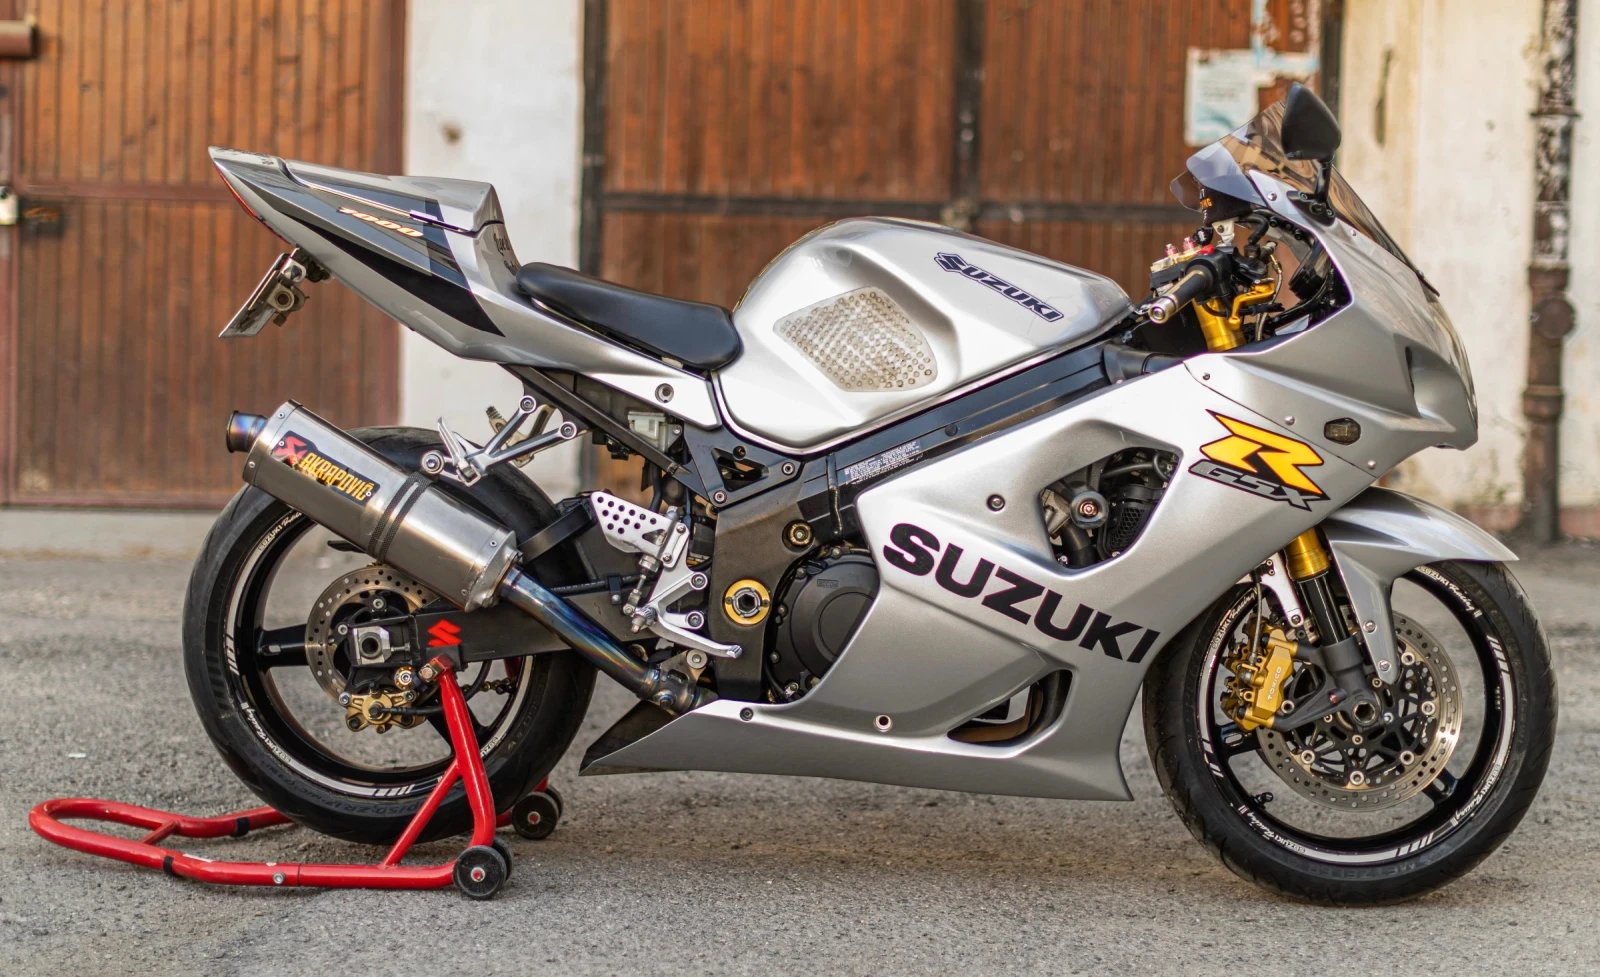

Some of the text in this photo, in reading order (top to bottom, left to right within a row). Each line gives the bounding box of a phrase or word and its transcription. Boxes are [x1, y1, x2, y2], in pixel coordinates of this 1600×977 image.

[337, 206, 424, 237] 1000
[934, 252, 1064, 322] SUZUKI
[1419, 566, 1449, 586] SUZUKI
[883, 523, 1160, 664] SUZUKI
[1267, 666, 1282, 701] TOKICO
[1307, 860, 1416, 879] METZELER
